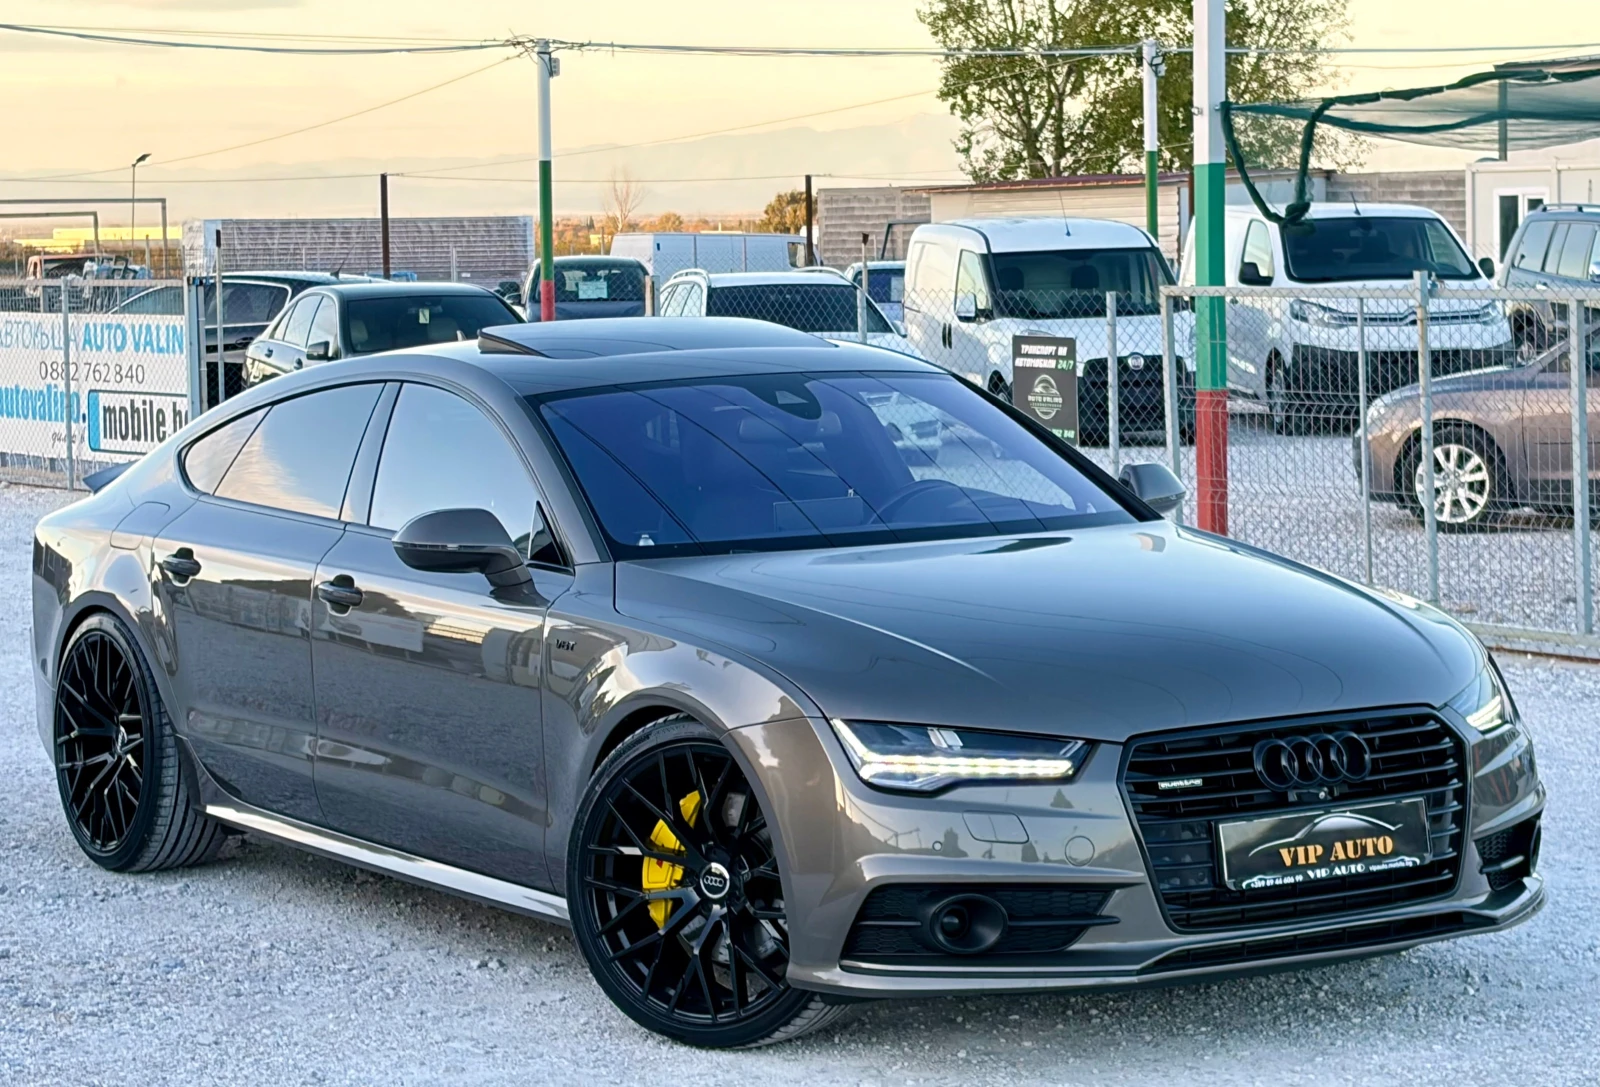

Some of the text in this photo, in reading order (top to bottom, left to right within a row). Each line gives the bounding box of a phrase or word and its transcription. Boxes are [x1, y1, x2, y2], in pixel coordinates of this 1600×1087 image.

[82, 322, 127, 353] AUTO
[131, 323, 184, 354] VALIN
[83, 362, 111, 383] 762
[114, 363, 145, 384] 840
[1057, 359, 1074, 371] 24/7
[1279, 836, 1393, 867] VIP AUTO
[1306, 867, 1330, 879] VIP
[1332, 863, 1366, 876] AUTO
